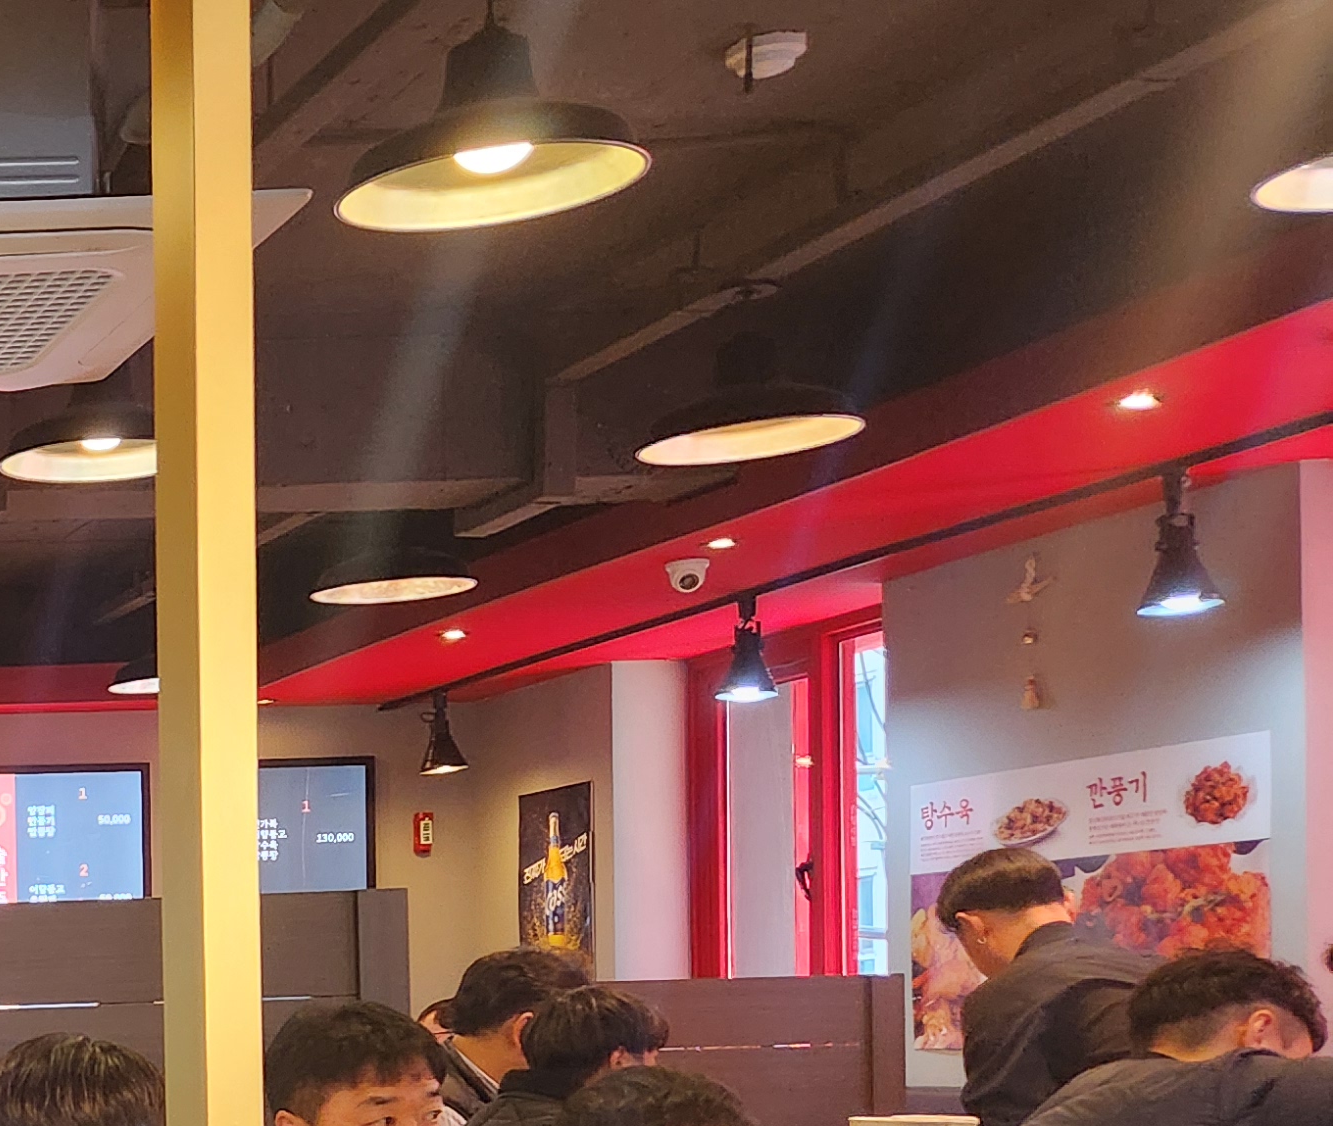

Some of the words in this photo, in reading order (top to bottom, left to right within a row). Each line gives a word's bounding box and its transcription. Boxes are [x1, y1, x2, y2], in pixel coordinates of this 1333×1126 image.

[78, 787, 88, 799] 1
[1086, 771, 1148, 809] 깐풍기
[301, 800, 311, 813] 1
[920, 799, 974, 831] 탕수육
[258, 818, 279, 829] 가복
[316, 832, 355, 844] 130,000
[258, 840, 279, 850] 수육
[79, 863, 89, 877] 2
